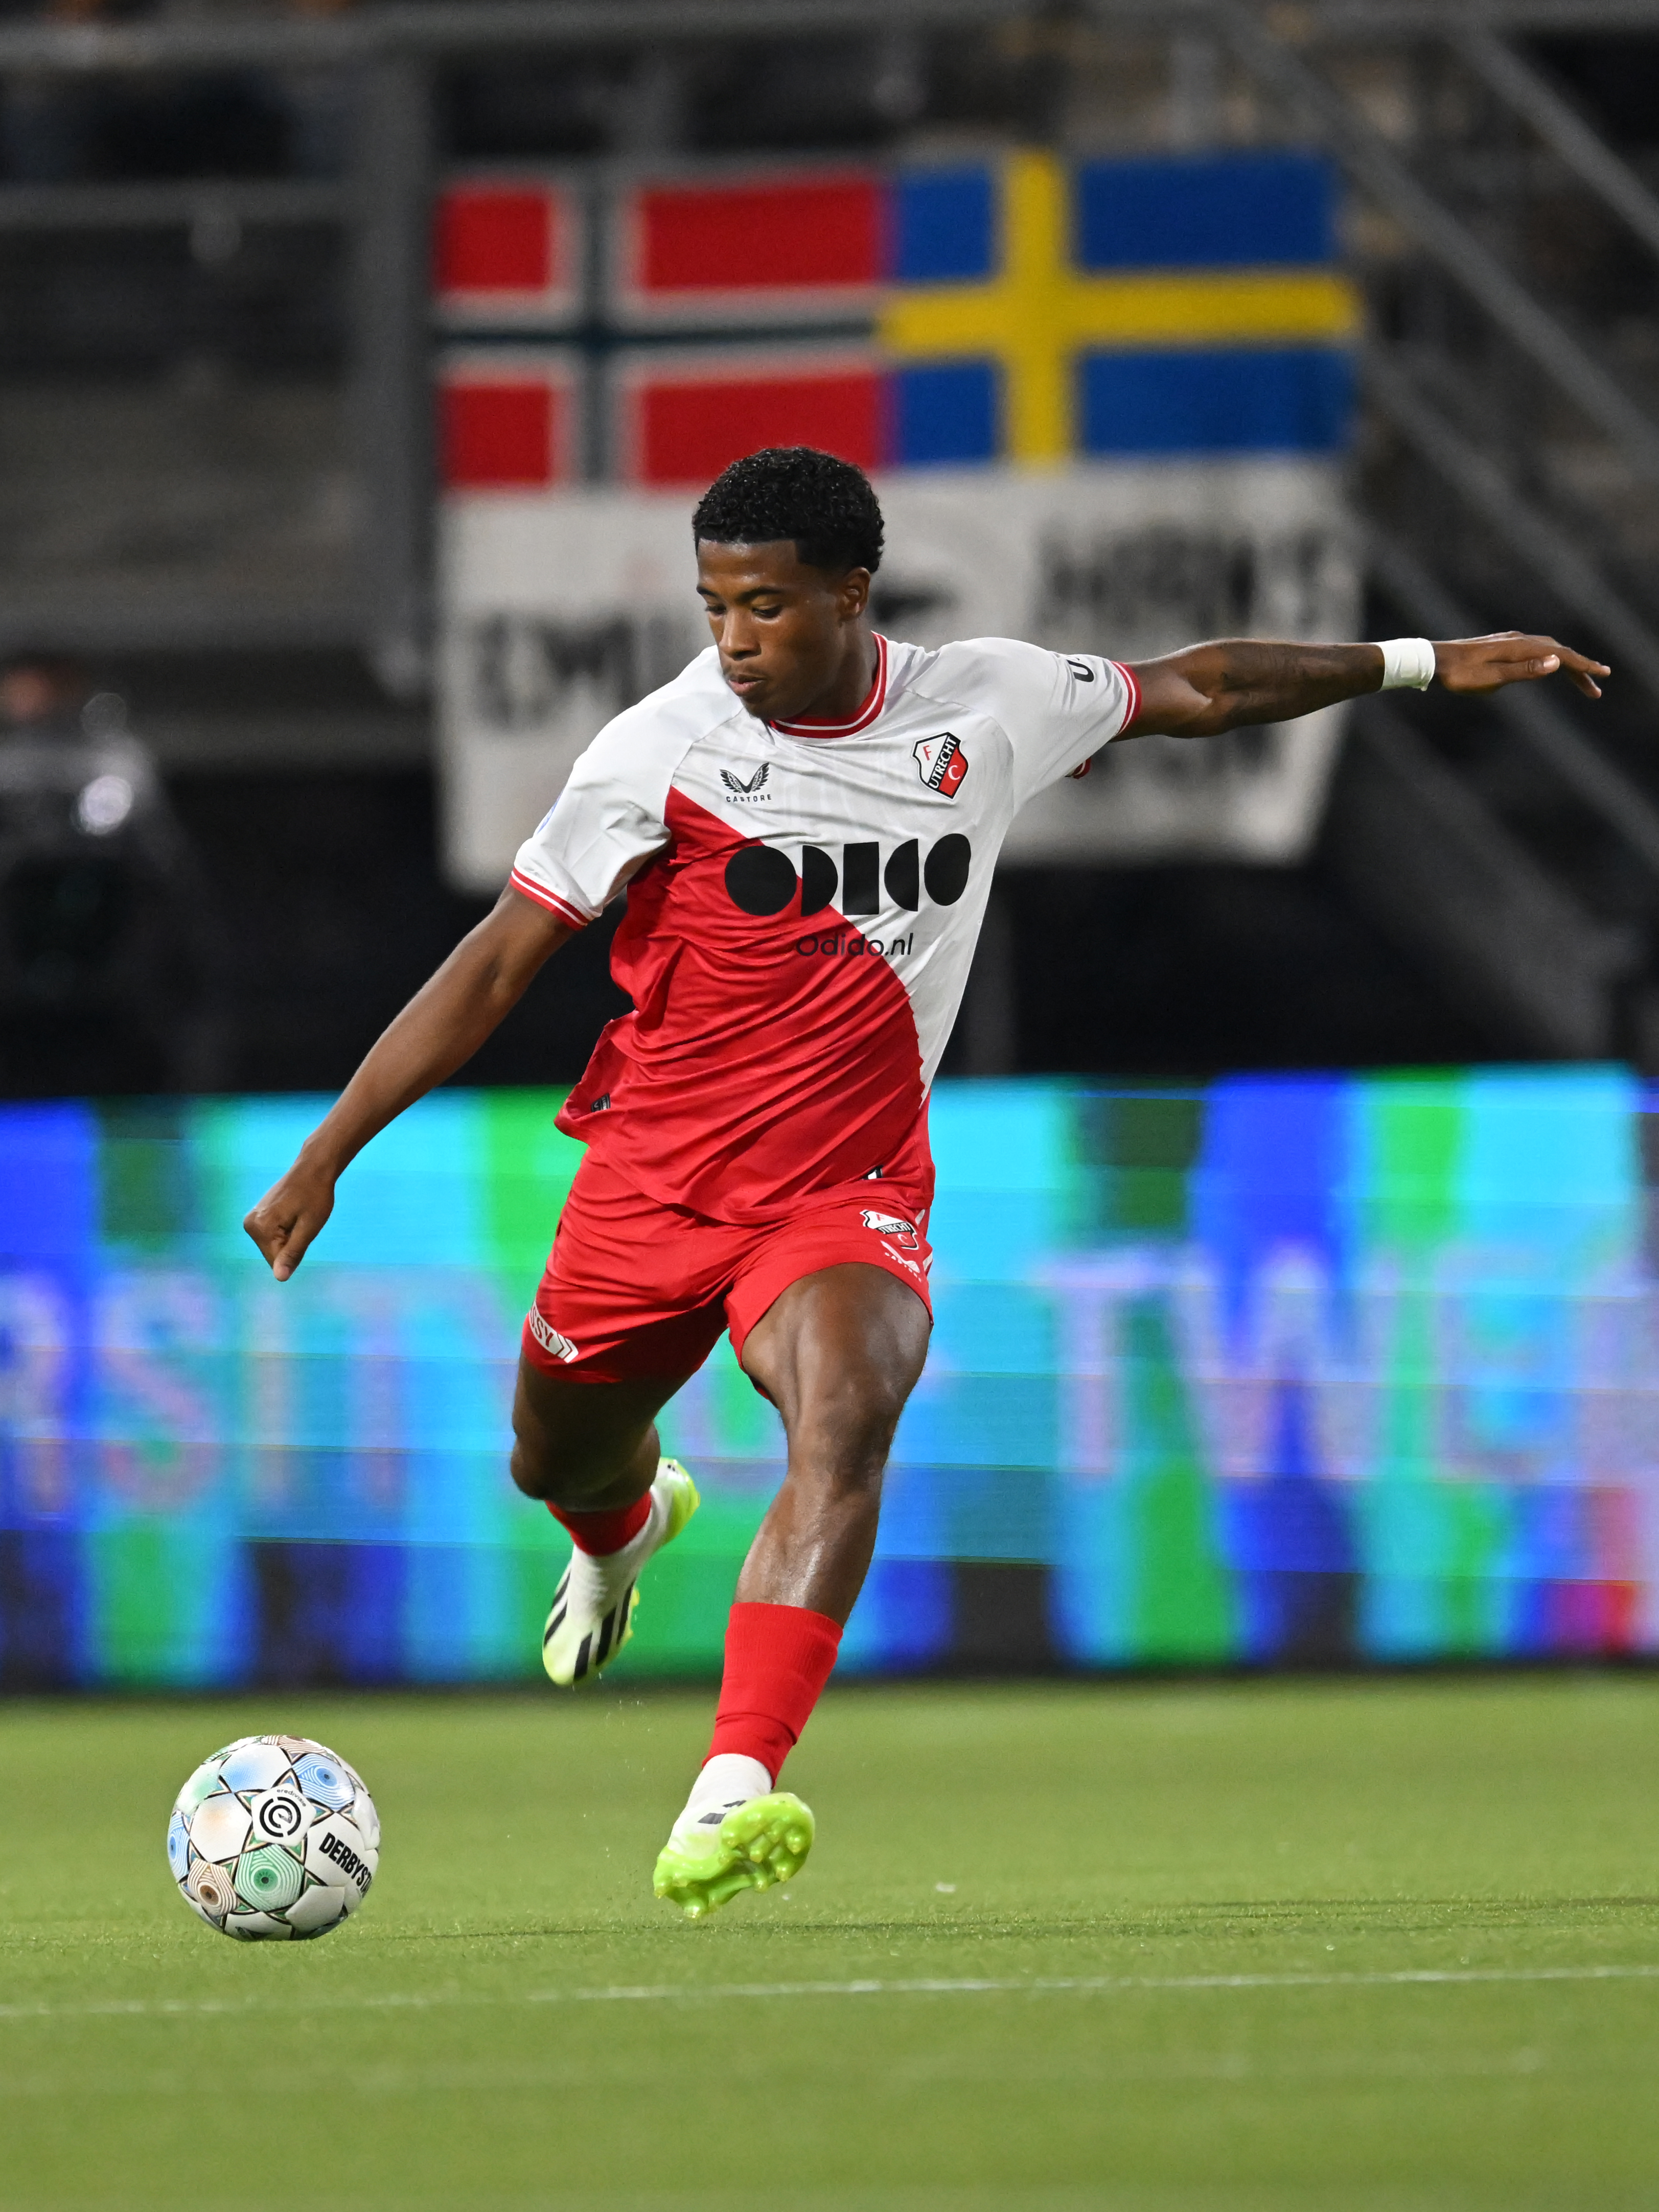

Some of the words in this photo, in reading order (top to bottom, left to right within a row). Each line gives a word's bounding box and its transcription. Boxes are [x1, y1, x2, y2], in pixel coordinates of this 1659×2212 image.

[923, 745, 932, 761] F
[929, 736, 956, 788] UTRECHT
[948, 765, 960, 780] C
[726, 794, 772, 803] CASTORE
[796, 933, 913, 957] Odido.nl
[276, 1789, 306, 1807] eredivisie
